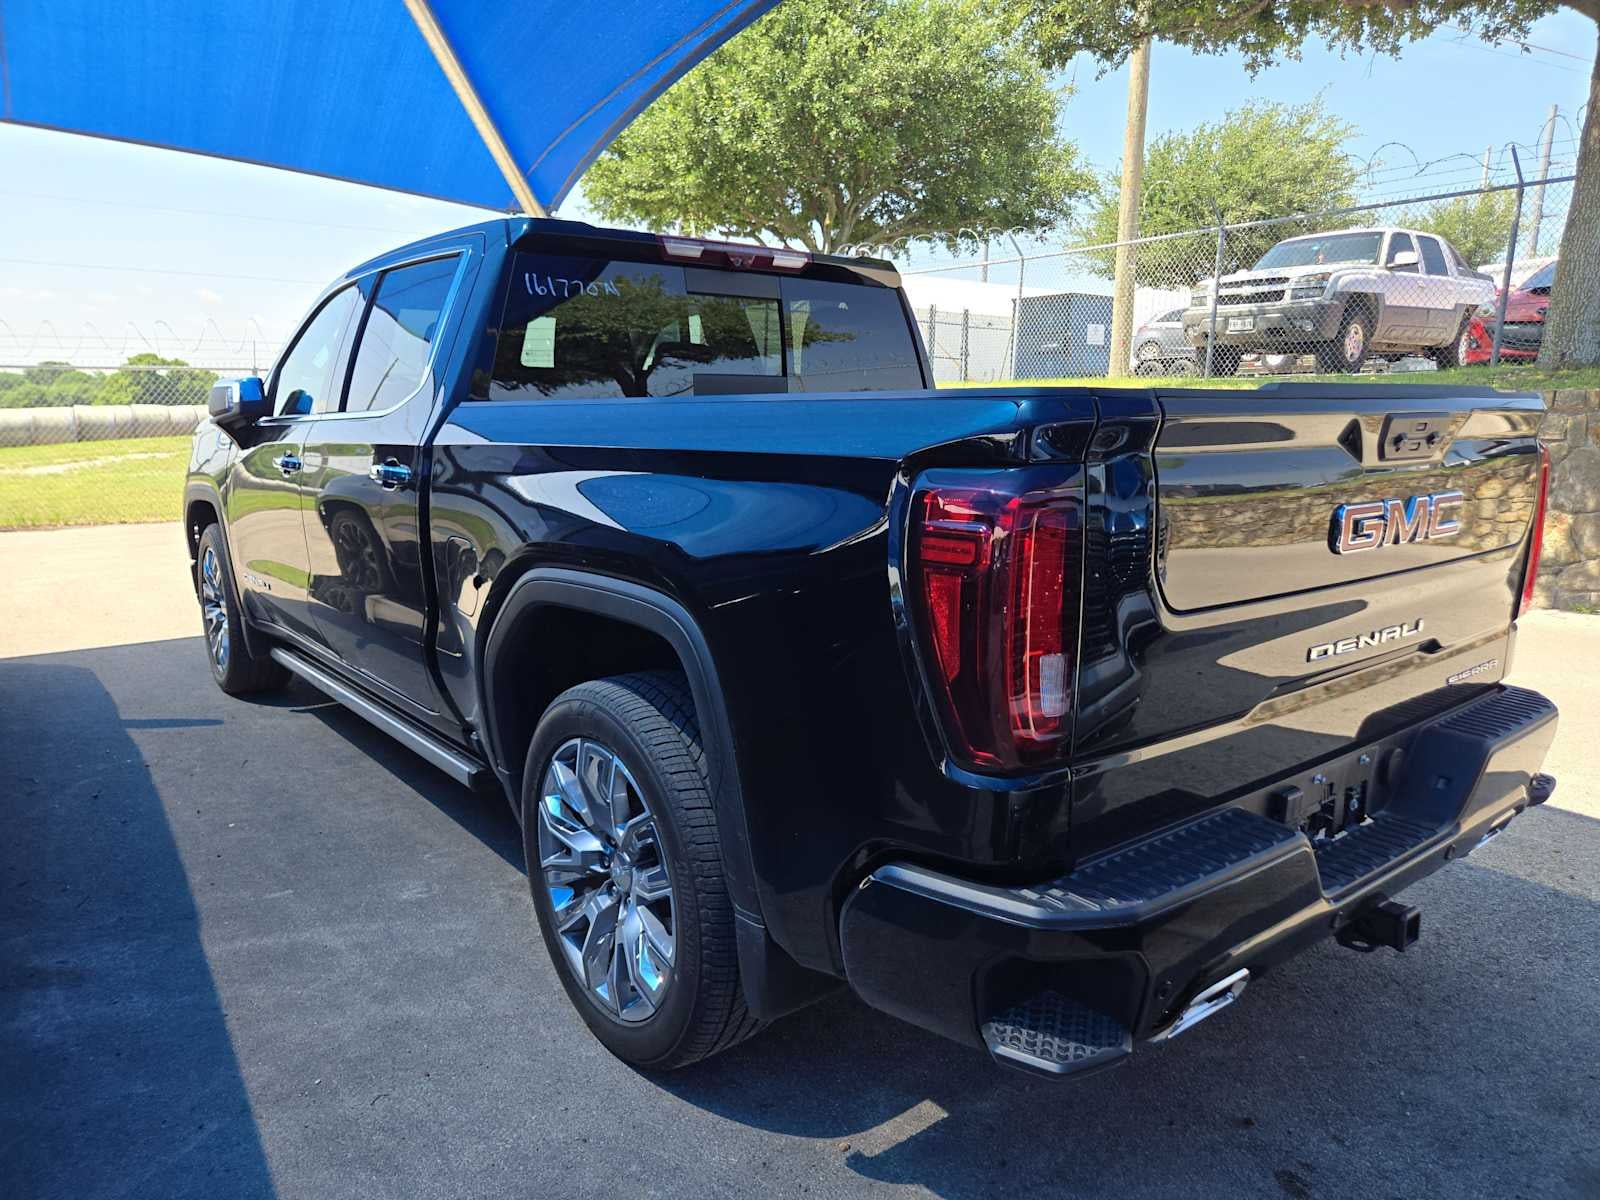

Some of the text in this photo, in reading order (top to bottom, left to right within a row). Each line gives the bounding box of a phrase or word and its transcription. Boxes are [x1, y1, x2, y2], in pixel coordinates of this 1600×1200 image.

[1334, 491, 1465, 555] GMC
[1306, 617, 1424, 662] DENALI
[1447, 658, 1498, 684] SIERRA
